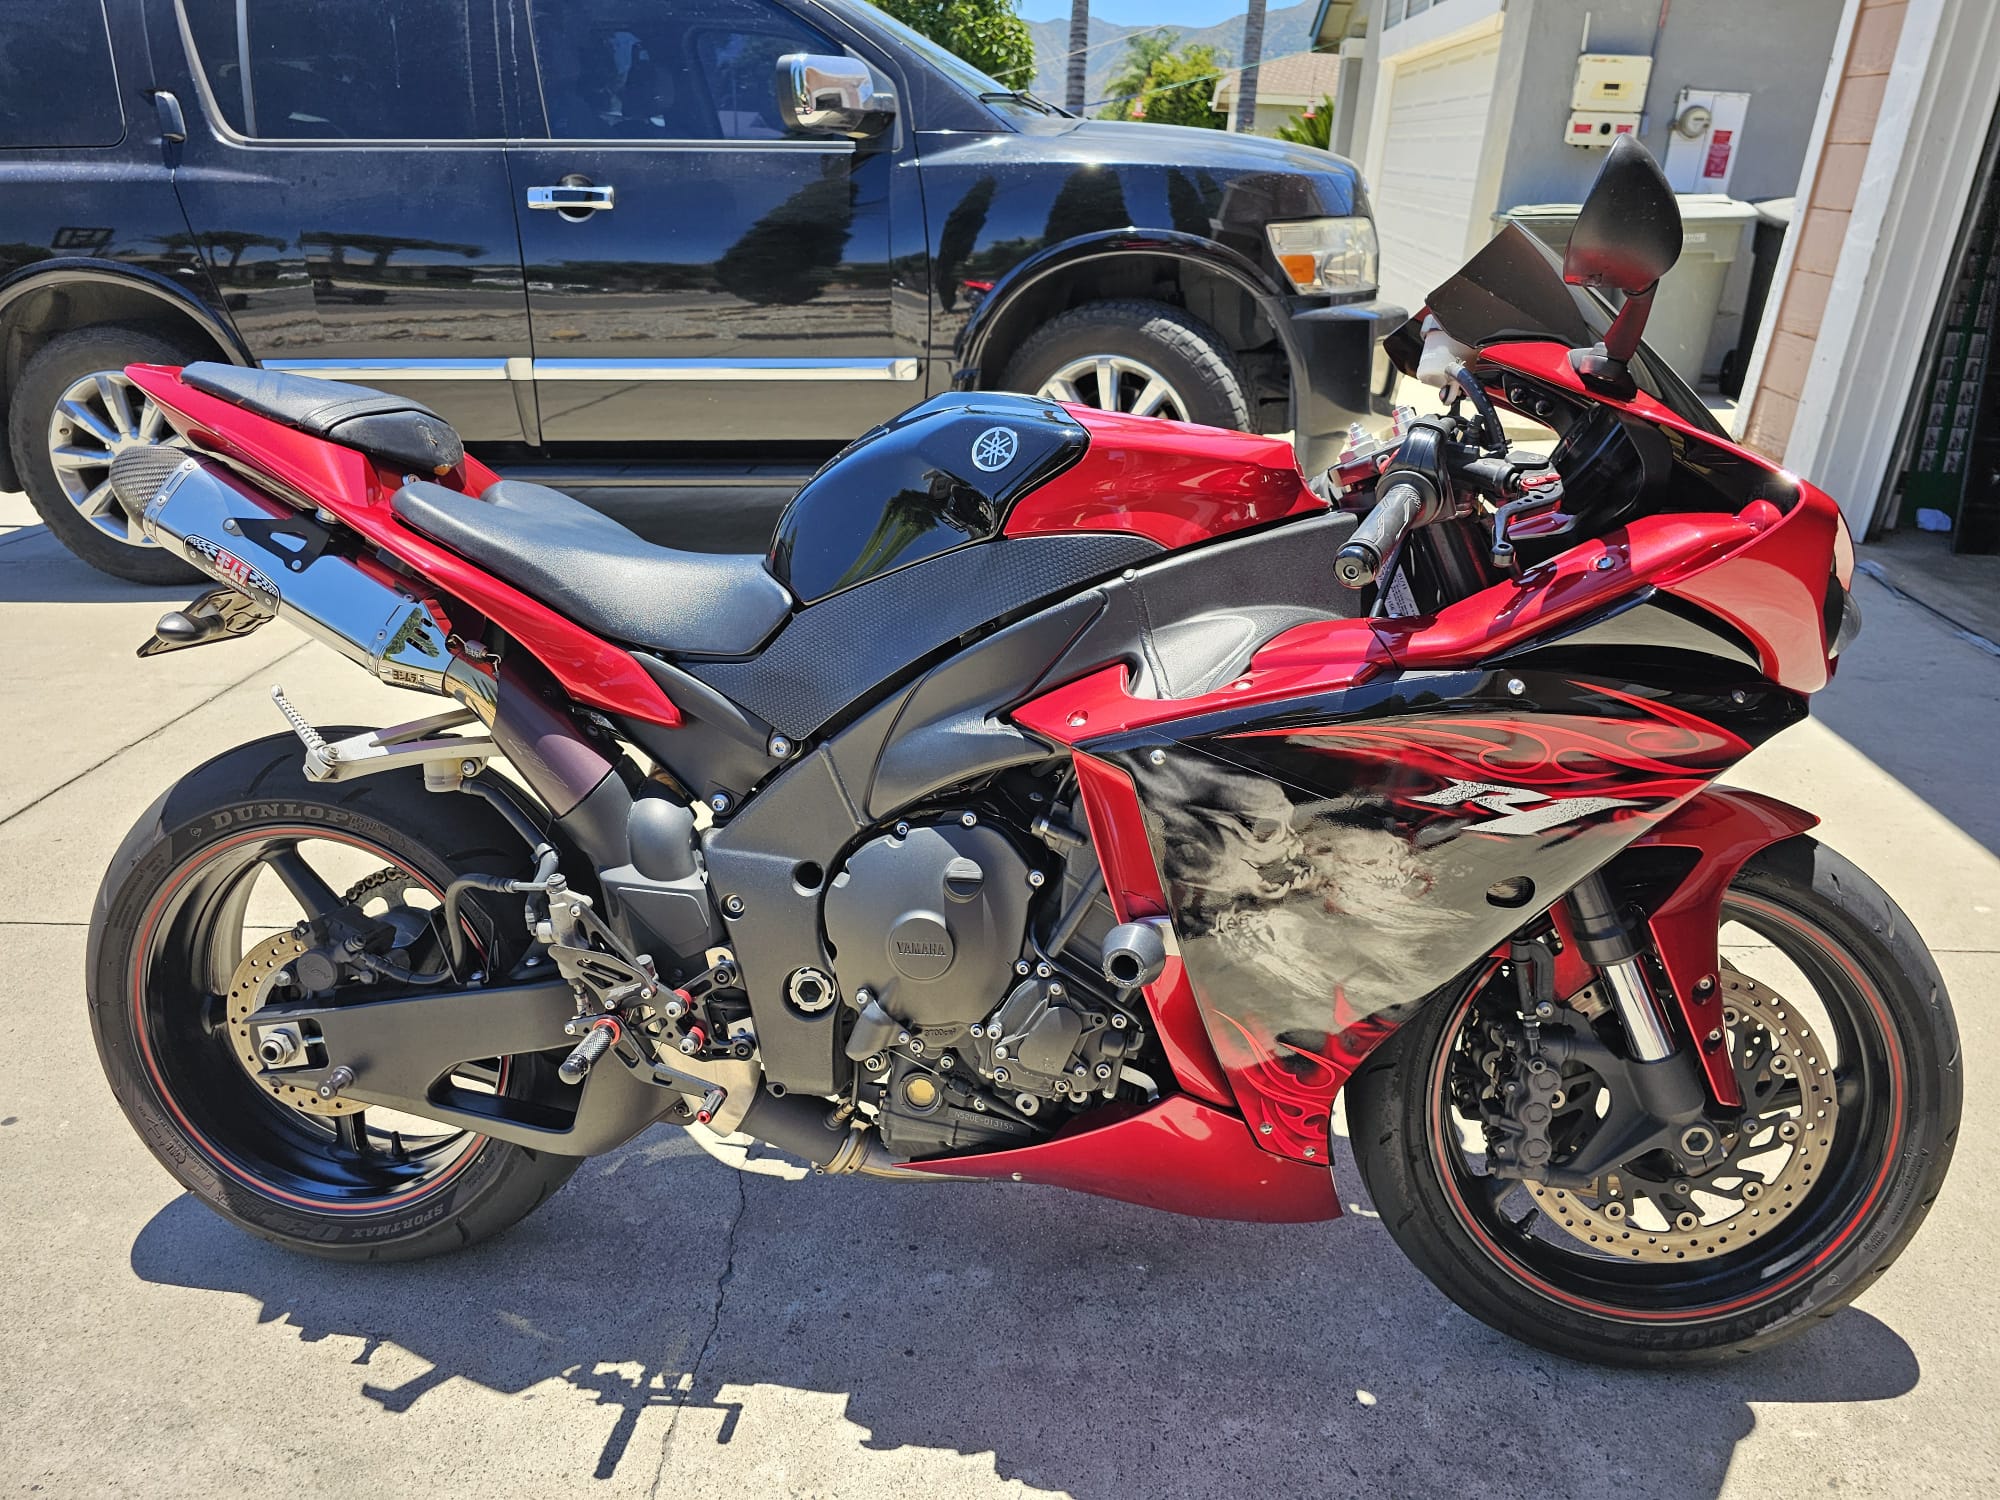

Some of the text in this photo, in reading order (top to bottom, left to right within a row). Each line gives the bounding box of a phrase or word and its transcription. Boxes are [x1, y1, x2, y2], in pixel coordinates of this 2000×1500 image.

[211, 803, 349, 830] DUNLOP
[897, 942, 947, 957] YAMAHA
[352, 1204, 444, 1238] SPORTMAX
